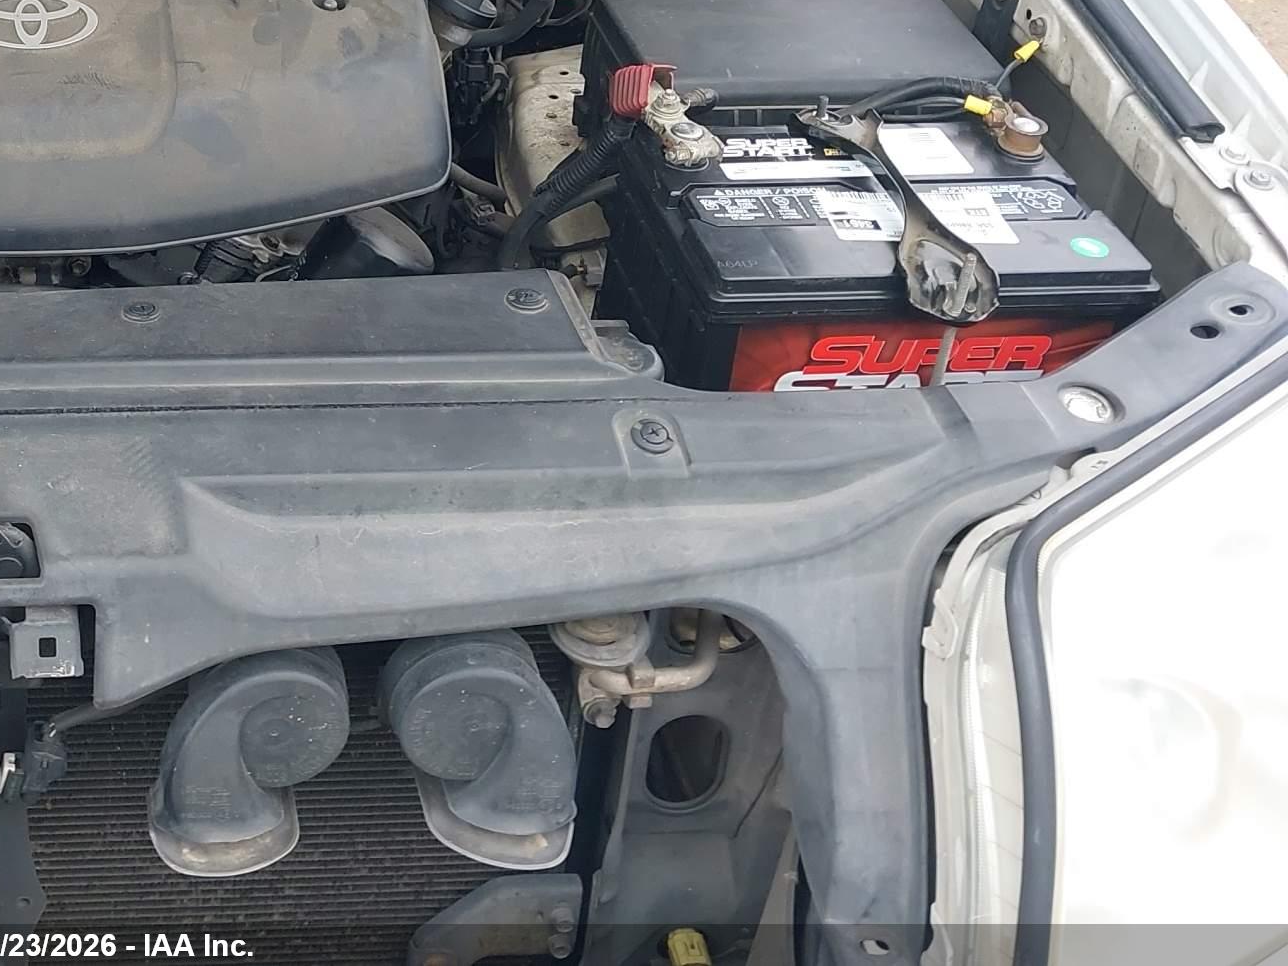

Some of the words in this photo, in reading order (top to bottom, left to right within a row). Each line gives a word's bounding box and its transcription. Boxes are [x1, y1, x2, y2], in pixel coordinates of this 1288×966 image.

[725, 137, 809, 147] SUPER
[722, 145, 814, 157] START
[724, 188, 773, 196] DANGER
